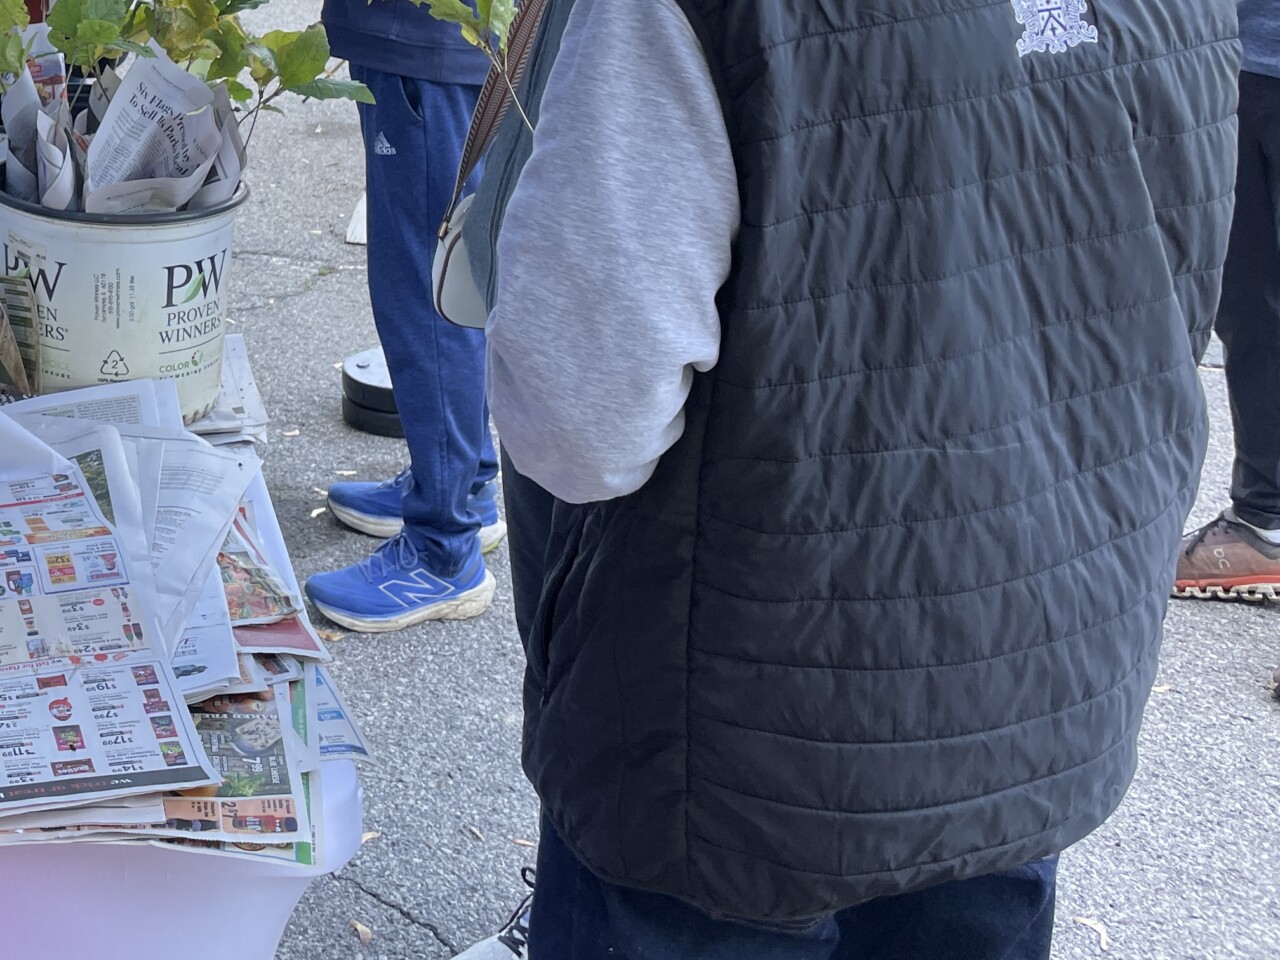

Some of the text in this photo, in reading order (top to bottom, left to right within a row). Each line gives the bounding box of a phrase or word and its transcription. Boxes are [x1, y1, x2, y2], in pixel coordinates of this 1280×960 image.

[129, 93, 138, 108] To
[139, 103, 158, 121] Sell
[137, 81, 149, 100] Six
[150, 95, 173, 115] Flags
[161, 248, 227, 308] PW
[166, 297, 220, 327] PROVEN
[158, 313, 222, 344] WINNERS
[112, 360, 118, 369] 2
[160, 361, 190, 373] COLOR
